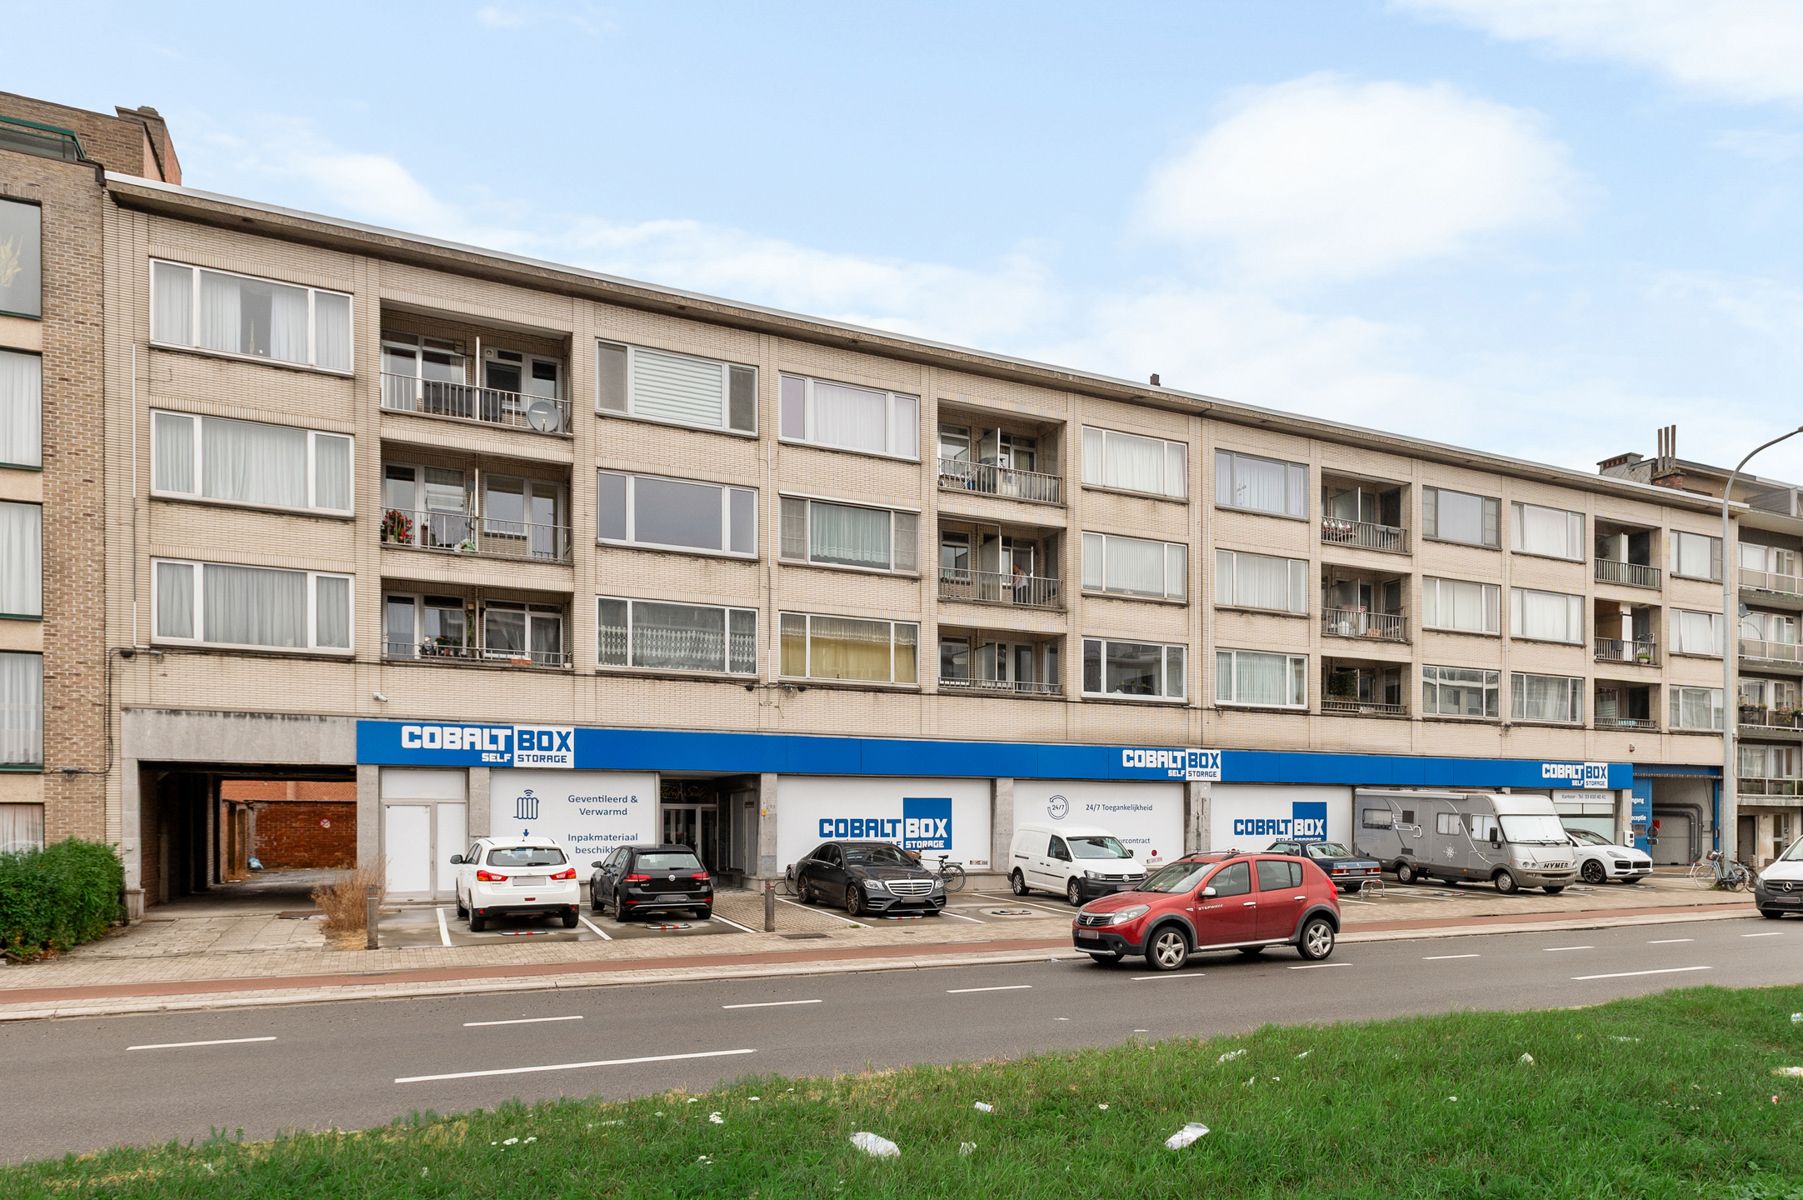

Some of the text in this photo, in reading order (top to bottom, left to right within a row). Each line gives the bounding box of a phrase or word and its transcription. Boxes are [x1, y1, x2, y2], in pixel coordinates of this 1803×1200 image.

[401, 725, 571, 752] COBALT BOX
[481, 752, 567, 763] SELF STORAGE
[1122, 749, 1219, 769] COBALT BOX
[1167, 769, 1186, 777] SELF
[1542, 763, 1607, 779] COBALT BOX
[568, 794, 638, 803] Geventileerd &
[579, 807, 628, 816] Verwarmd
[1102, 804, 1153, 812] Toegankelijkheid
[819, 818, 948, 838] COBALT BOX
[1233, 818, 1325, 836] COBALT BOX
[567, 833, 639, 843] Inpakmateriaal
[905, 840, 945, 849] STORAGE
[575, 846, 617, 855] beschikb
